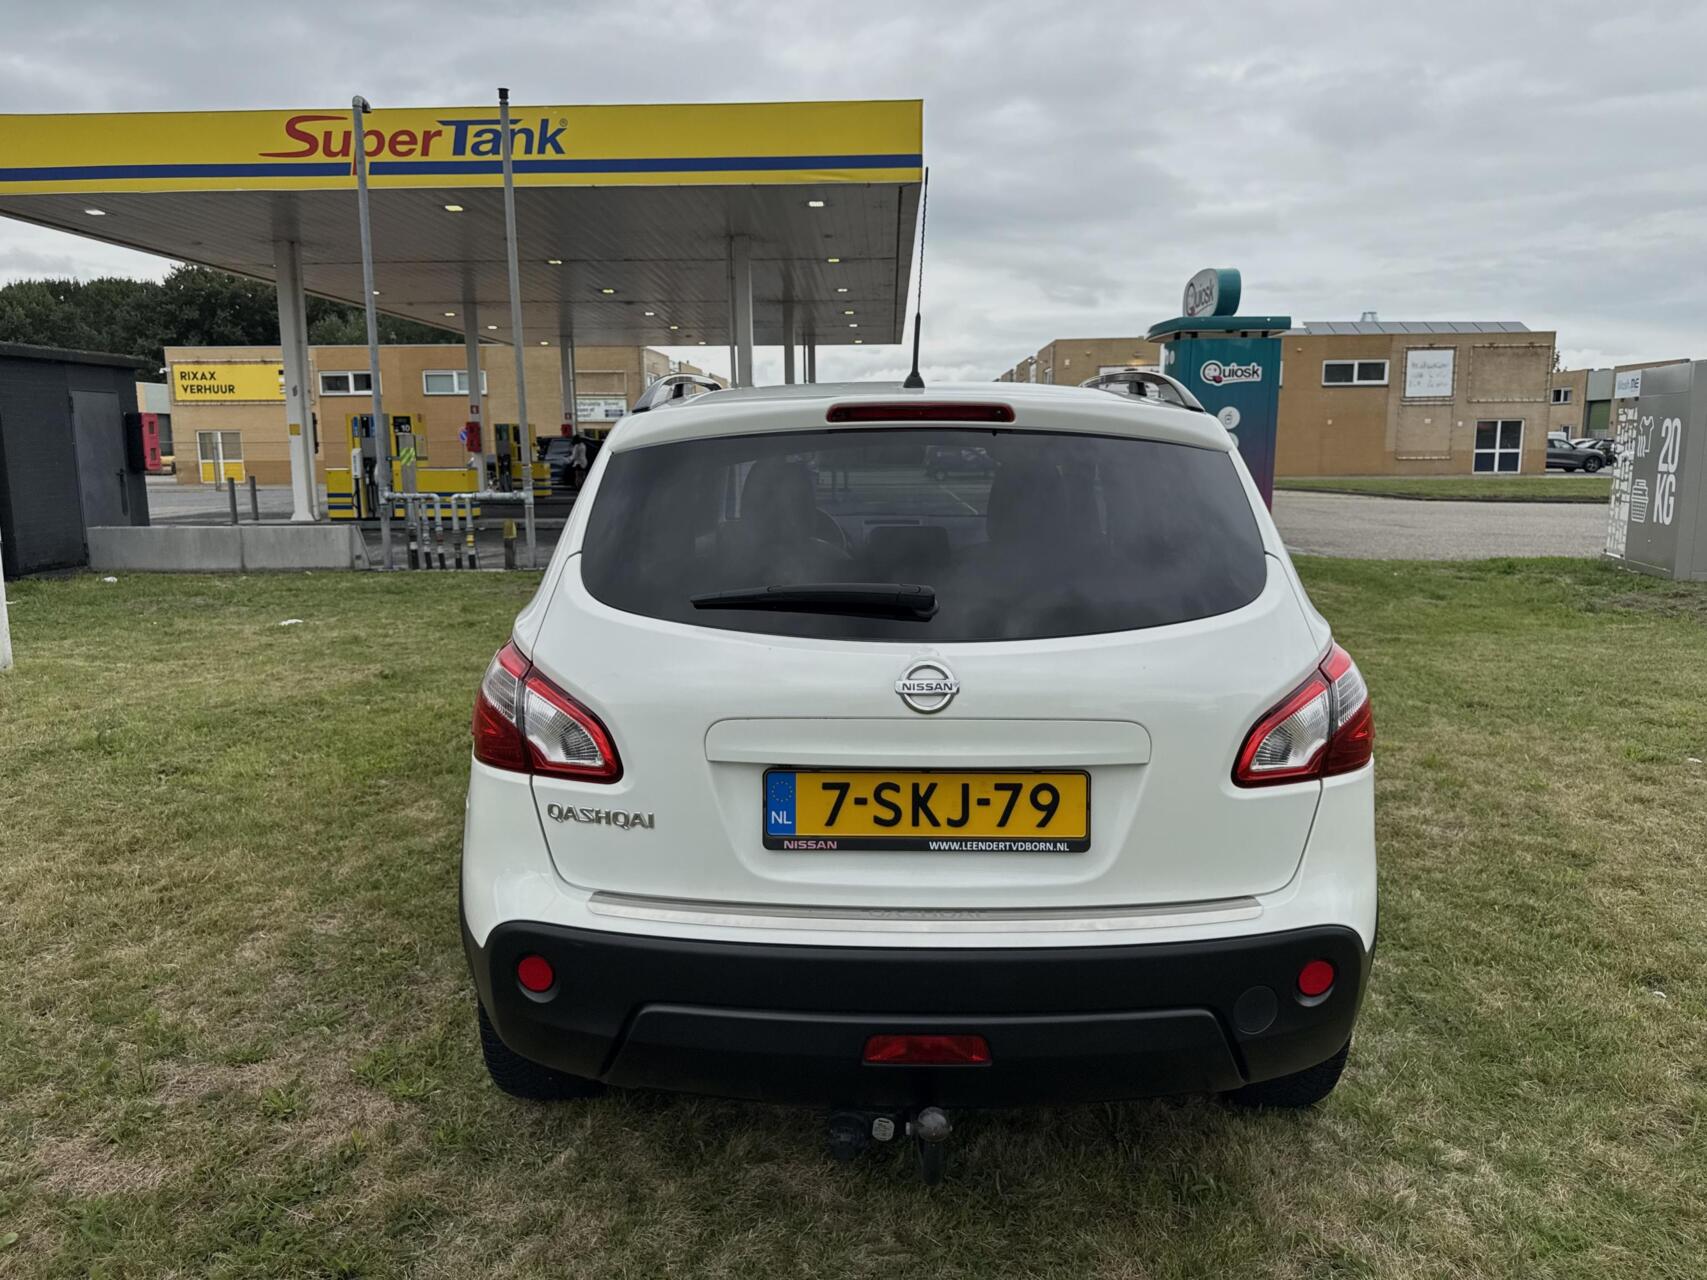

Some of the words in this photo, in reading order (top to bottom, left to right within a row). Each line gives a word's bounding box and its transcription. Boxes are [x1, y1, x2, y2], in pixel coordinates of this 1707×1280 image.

[1186, 277, 1215, 317] Quiosk
[180, 371, 216, 381] RIXAX
[1202, 362, 1261, 383] Quiosk
[181, 384, 236, 394] VERHUUR
[1658, 417, 1681, 474] 20
[1653, 473, 1676, 525] KG
[902, 682, 953, 692] NISSAN
[821, 782, 1061, 829] 7-SKJ-79
[547, 802, 655, 831] QASHQAI
[771, 810, 792, 824] NL
[783, 840, 838, 850] NISSAN
[929, 840, 1070, 852] WWW.LEENDERTVDBORN.NL
